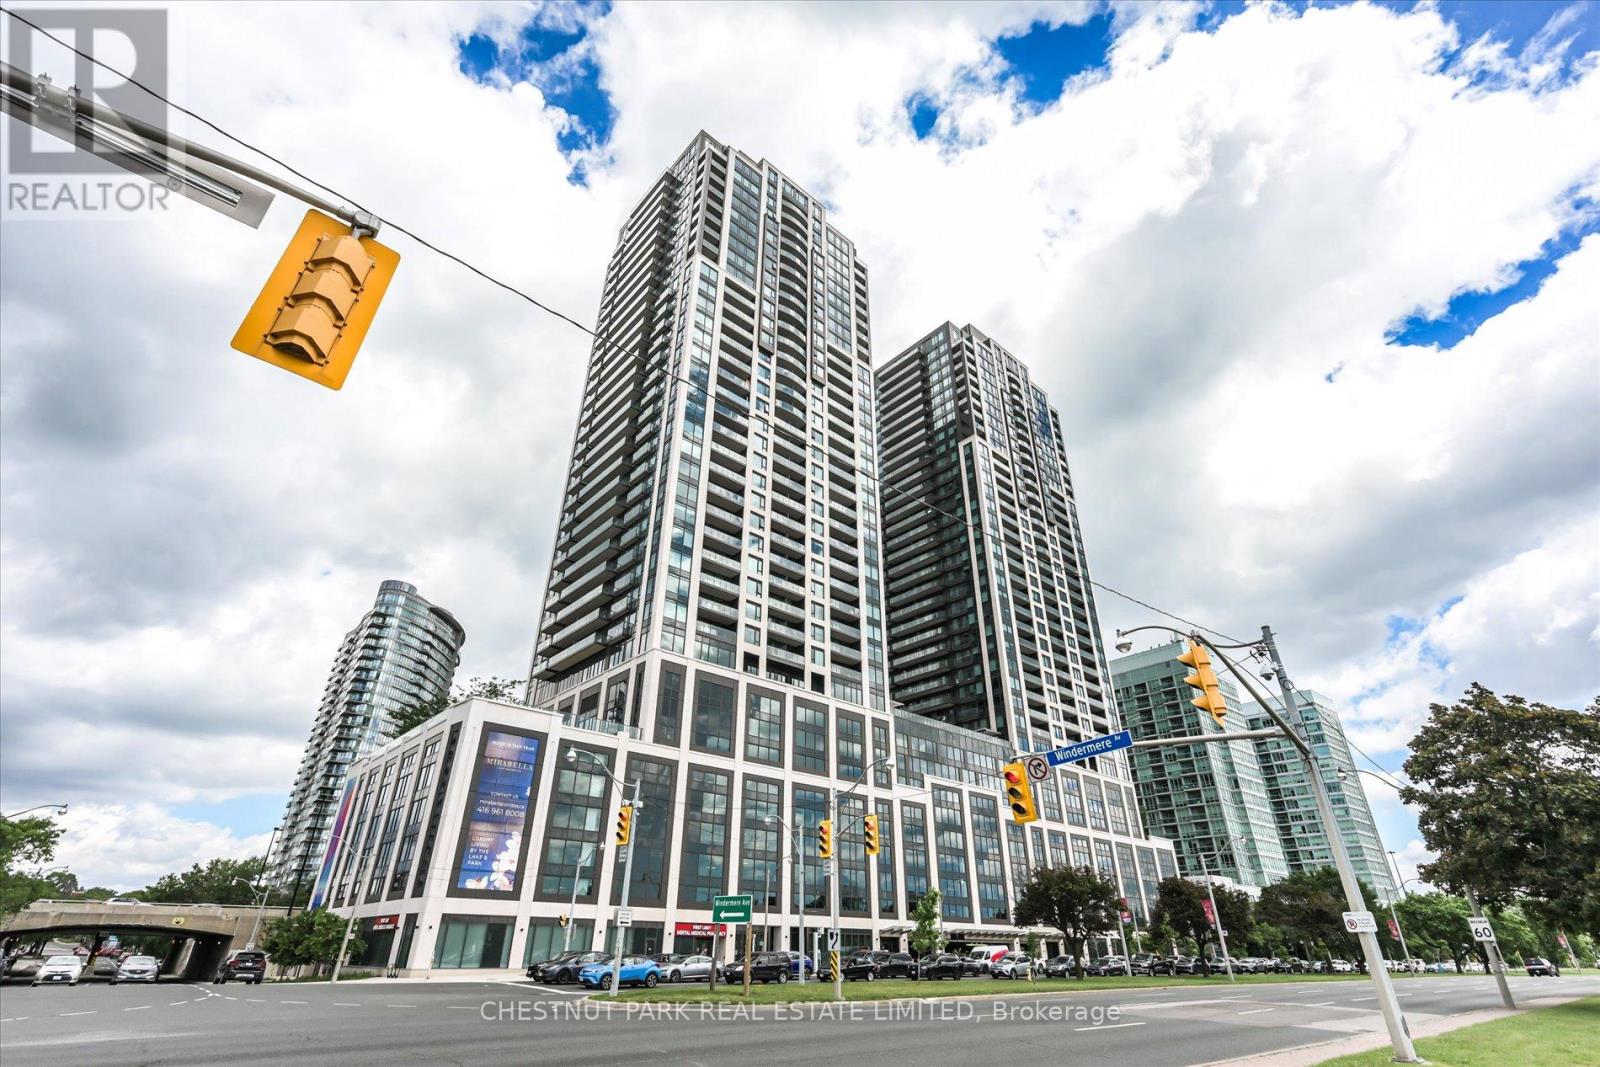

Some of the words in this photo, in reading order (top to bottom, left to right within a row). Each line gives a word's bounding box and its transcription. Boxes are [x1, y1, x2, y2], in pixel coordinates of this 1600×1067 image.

[1054, 739, 1112, 761] Windermere
[487, 757, 533, 770] MIRABELLA
[490, 791, 512, 799] CONTACT
[477, 806, 490, 814] 416
[491, 807, 504, 815] 961
[715, 899, 741, 907] Windermere
[742, 898, 751, 906] Ave
[1475, 927, 1491, 938] 60
